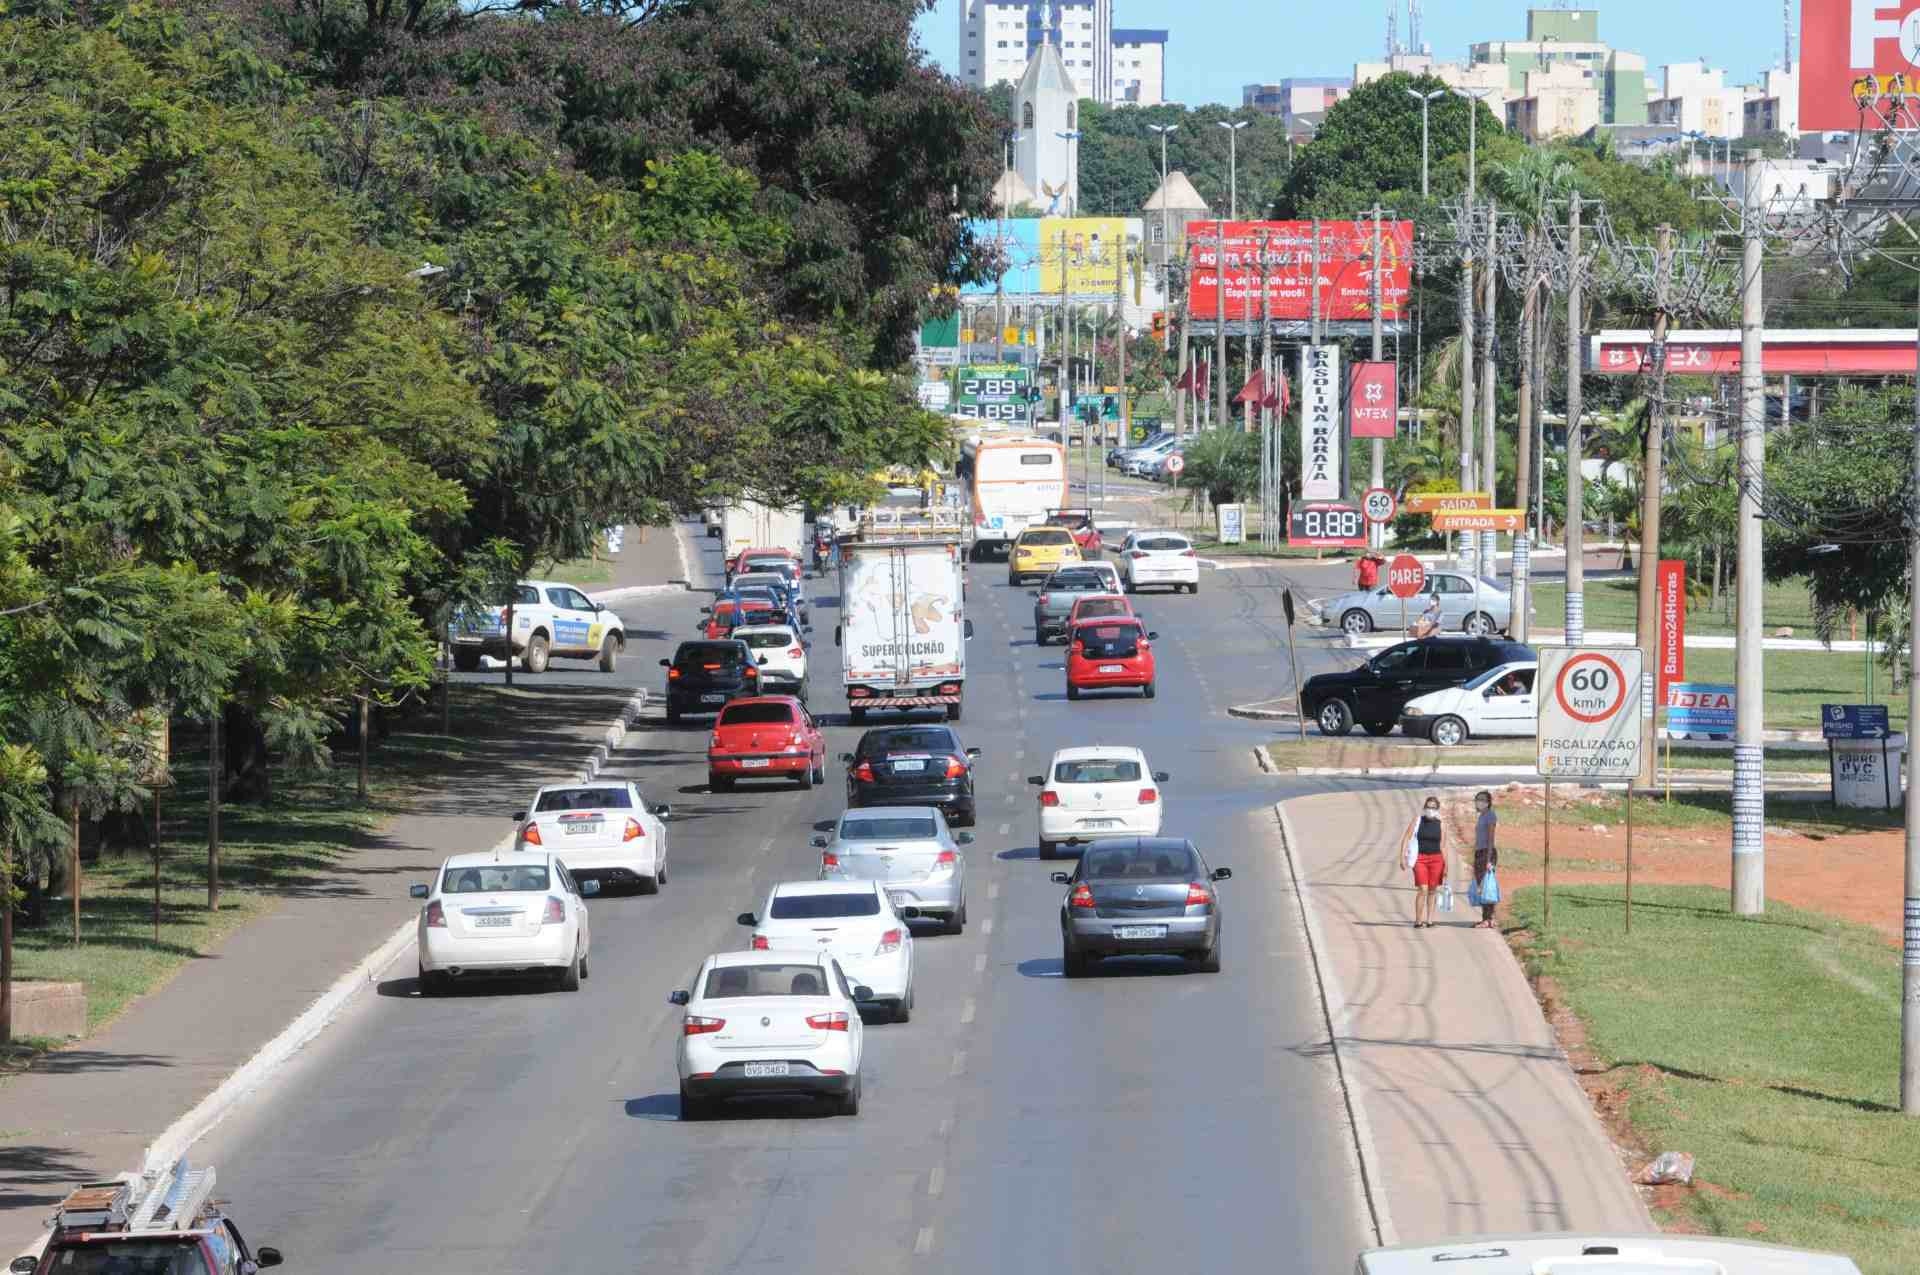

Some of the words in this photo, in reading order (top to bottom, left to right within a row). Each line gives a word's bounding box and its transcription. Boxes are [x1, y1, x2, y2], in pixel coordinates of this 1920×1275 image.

[1312, 350, 1329, 422] GASOLINA
[1312, 427, 1329, 480] BARATA
[1369, 495, 1390, 508] 60
[1445, 517, 1496, 528] ENTRADA
[1390, 568, 1422, 585] PARE
[1664, 572, 1677, 675] Banco24Horas
[1571, 667, 1608, 691] 60
[1573, 697, 1606, 709] km/h
[1543, 737, 1636, 753] FISCALIZAÇÃO
